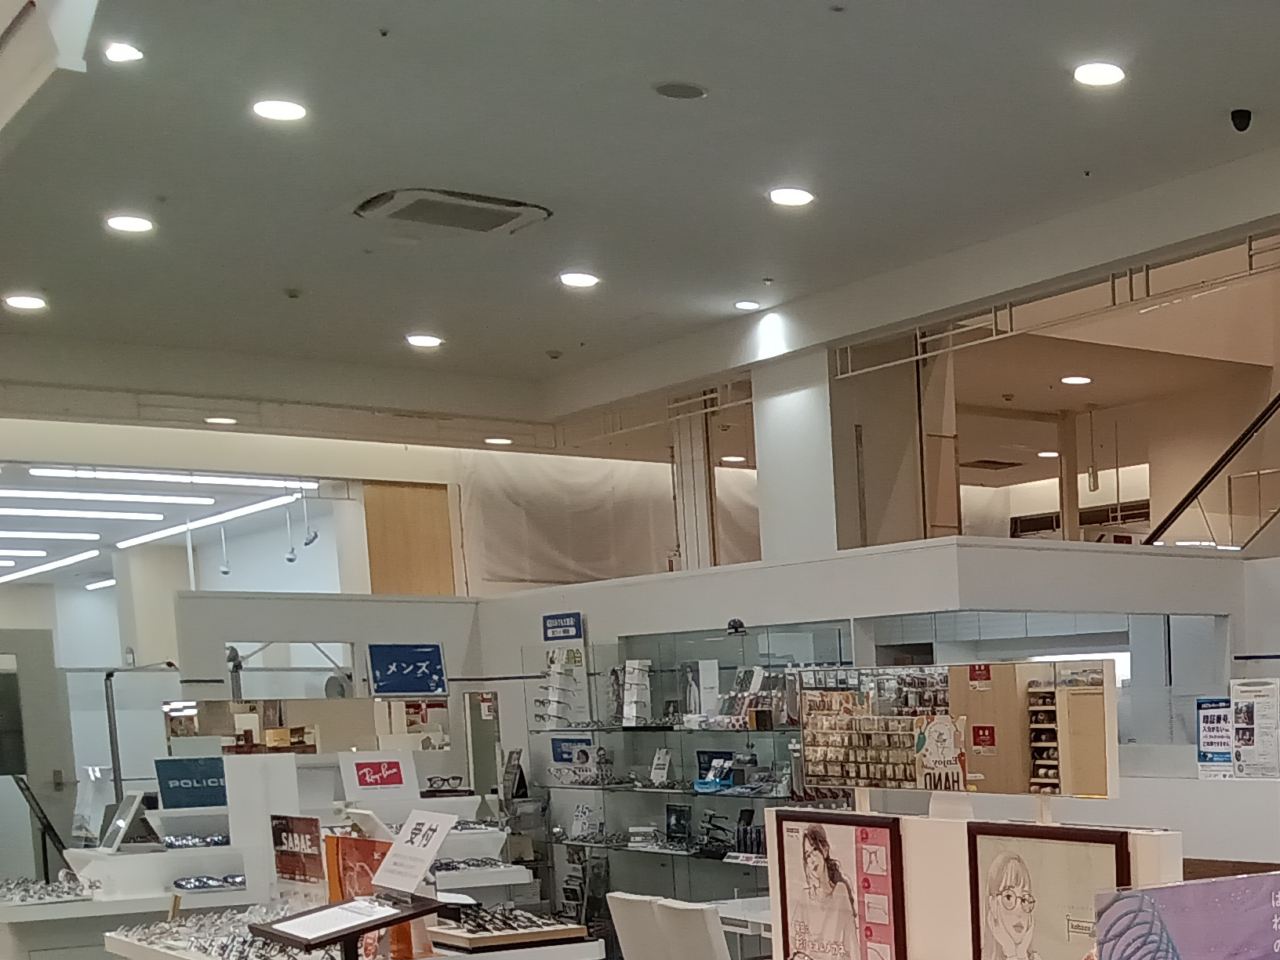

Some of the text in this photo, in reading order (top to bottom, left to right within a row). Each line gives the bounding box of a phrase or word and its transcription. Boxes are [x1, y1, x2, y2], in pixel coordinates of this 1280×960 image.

[386, 661, 430, 676] メンズ
[281, 831, 312, 851] SABAE
